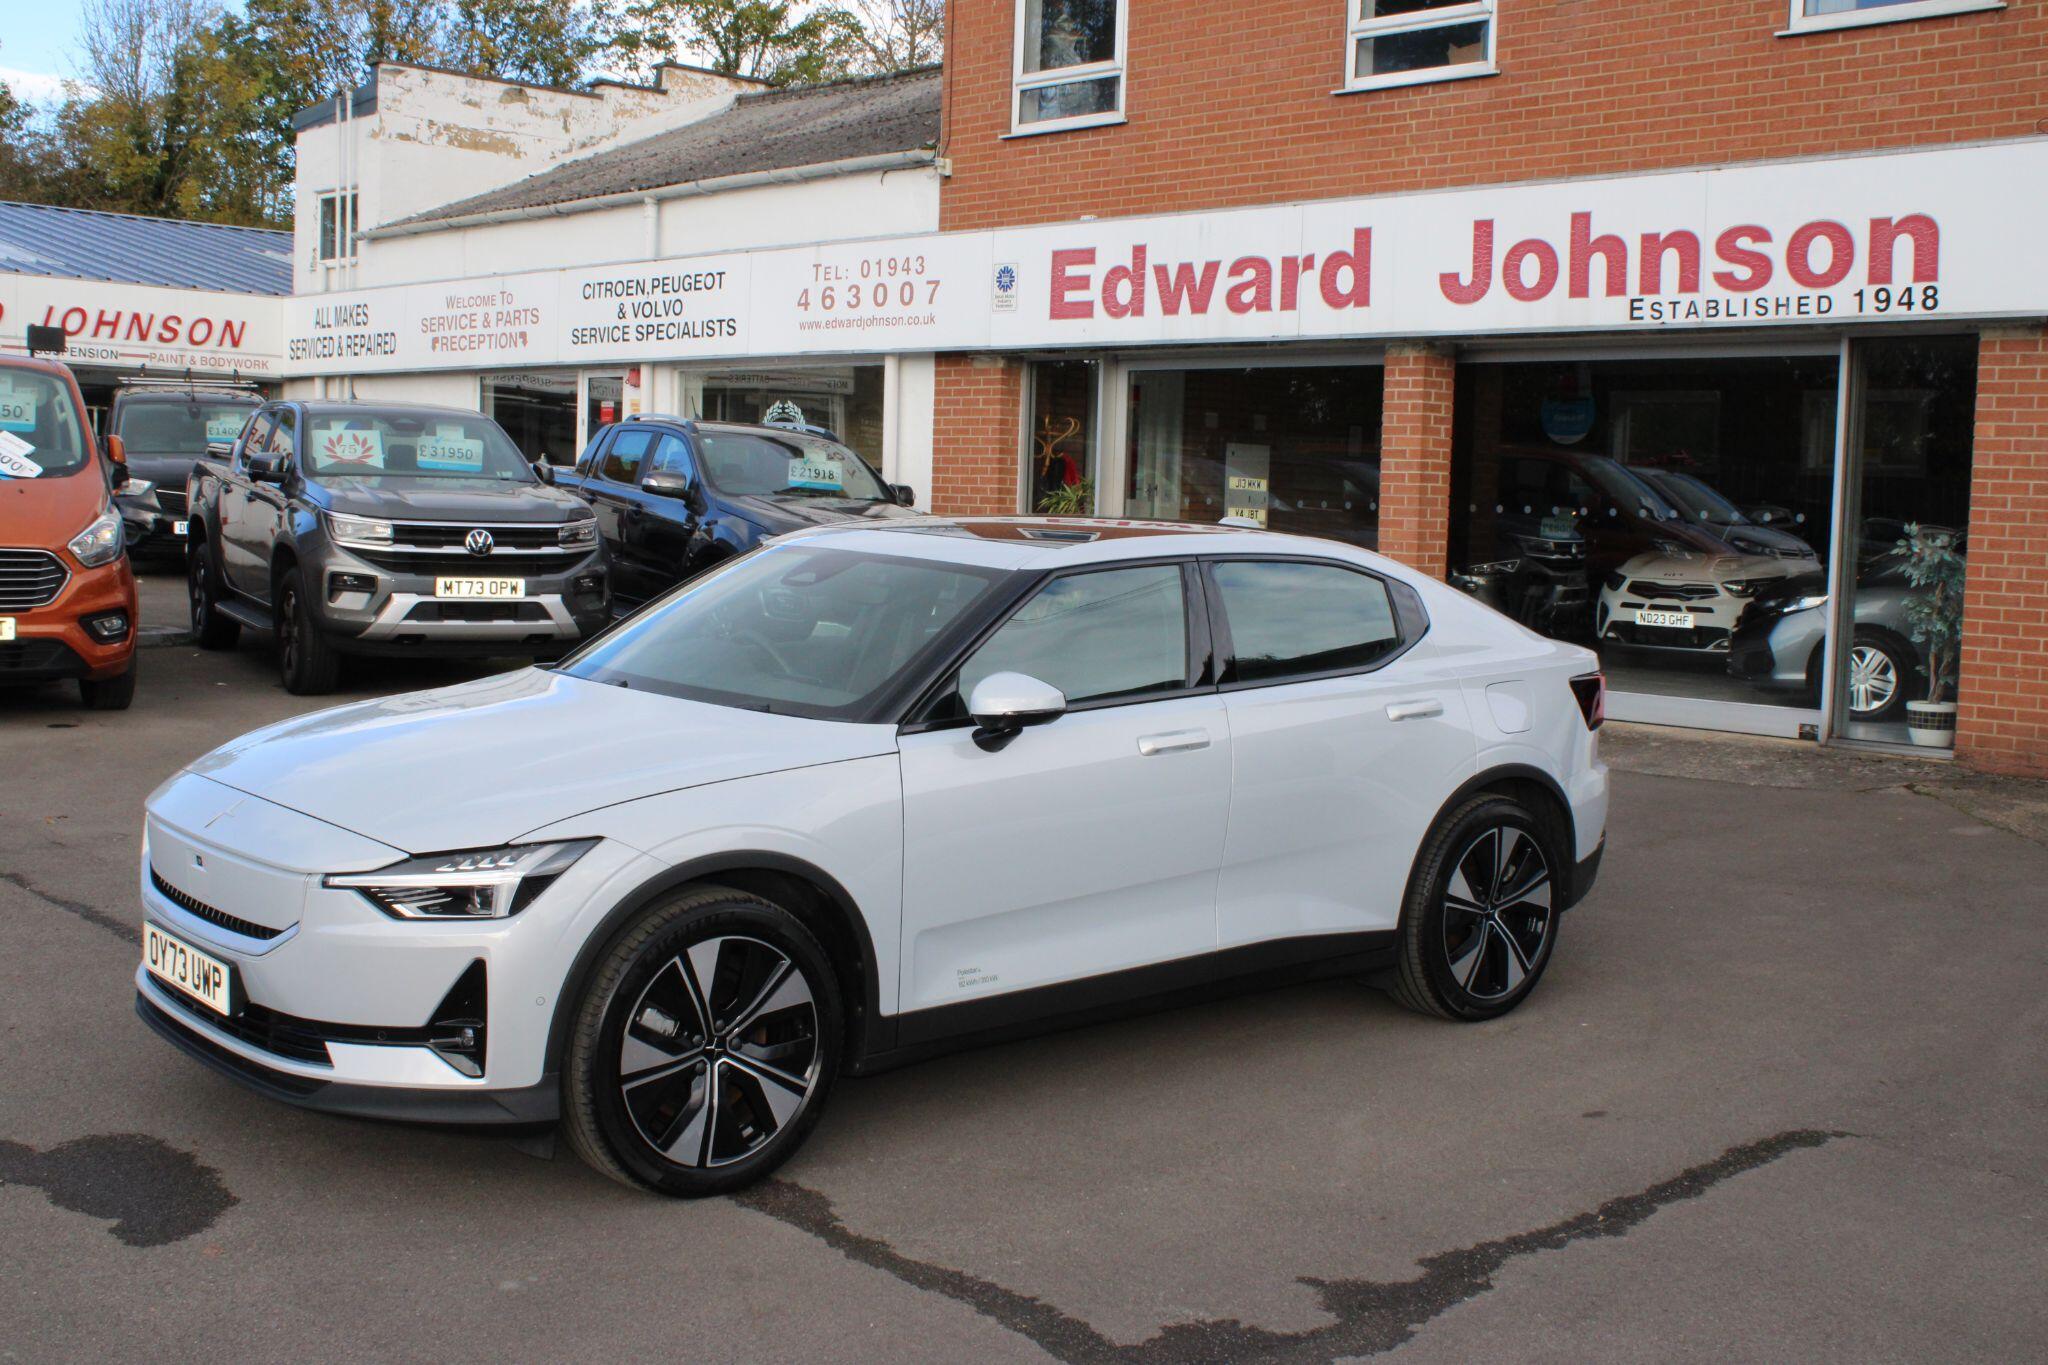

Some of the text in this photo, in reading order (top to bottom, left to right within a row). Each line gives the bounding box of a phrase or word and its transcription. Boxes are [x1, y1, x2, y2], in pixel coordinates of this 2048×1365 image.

[813, 256, 925, 281] TEL: 01943
[1049, 211, 1940, 320] Edward Johnson
[446, 295, 497, 309] WELCOME
[617, 299, 683, 319] & VOLVO
[1629, 285, 1940, 322] ESTABLISHED 1948
[315, 303, 369, 329] ALL MAKES
[421, 308, 540, 334] SERVICE & PARTS
[800, 313, 936, 330] www.edwardjohnson.co.uk
[441, 332, 518, 352] RECEPTION
[571, 318, 737, 345] SERVICE SPECIALISTS
[289, 332, 397, 360] SERVICED & REPAIRED
[149, 352, 186, 364] PAINT
[188, 355, 197, 366] &
[200, 356, 270, 370] BODYWORK
[419, 444, 473, 460] £31950
[443, 580, 518, 595] MT73 OPW
[1640, 612, 1666, 624] ND23
[150, 931, 222, 1001] OY73 UWP
